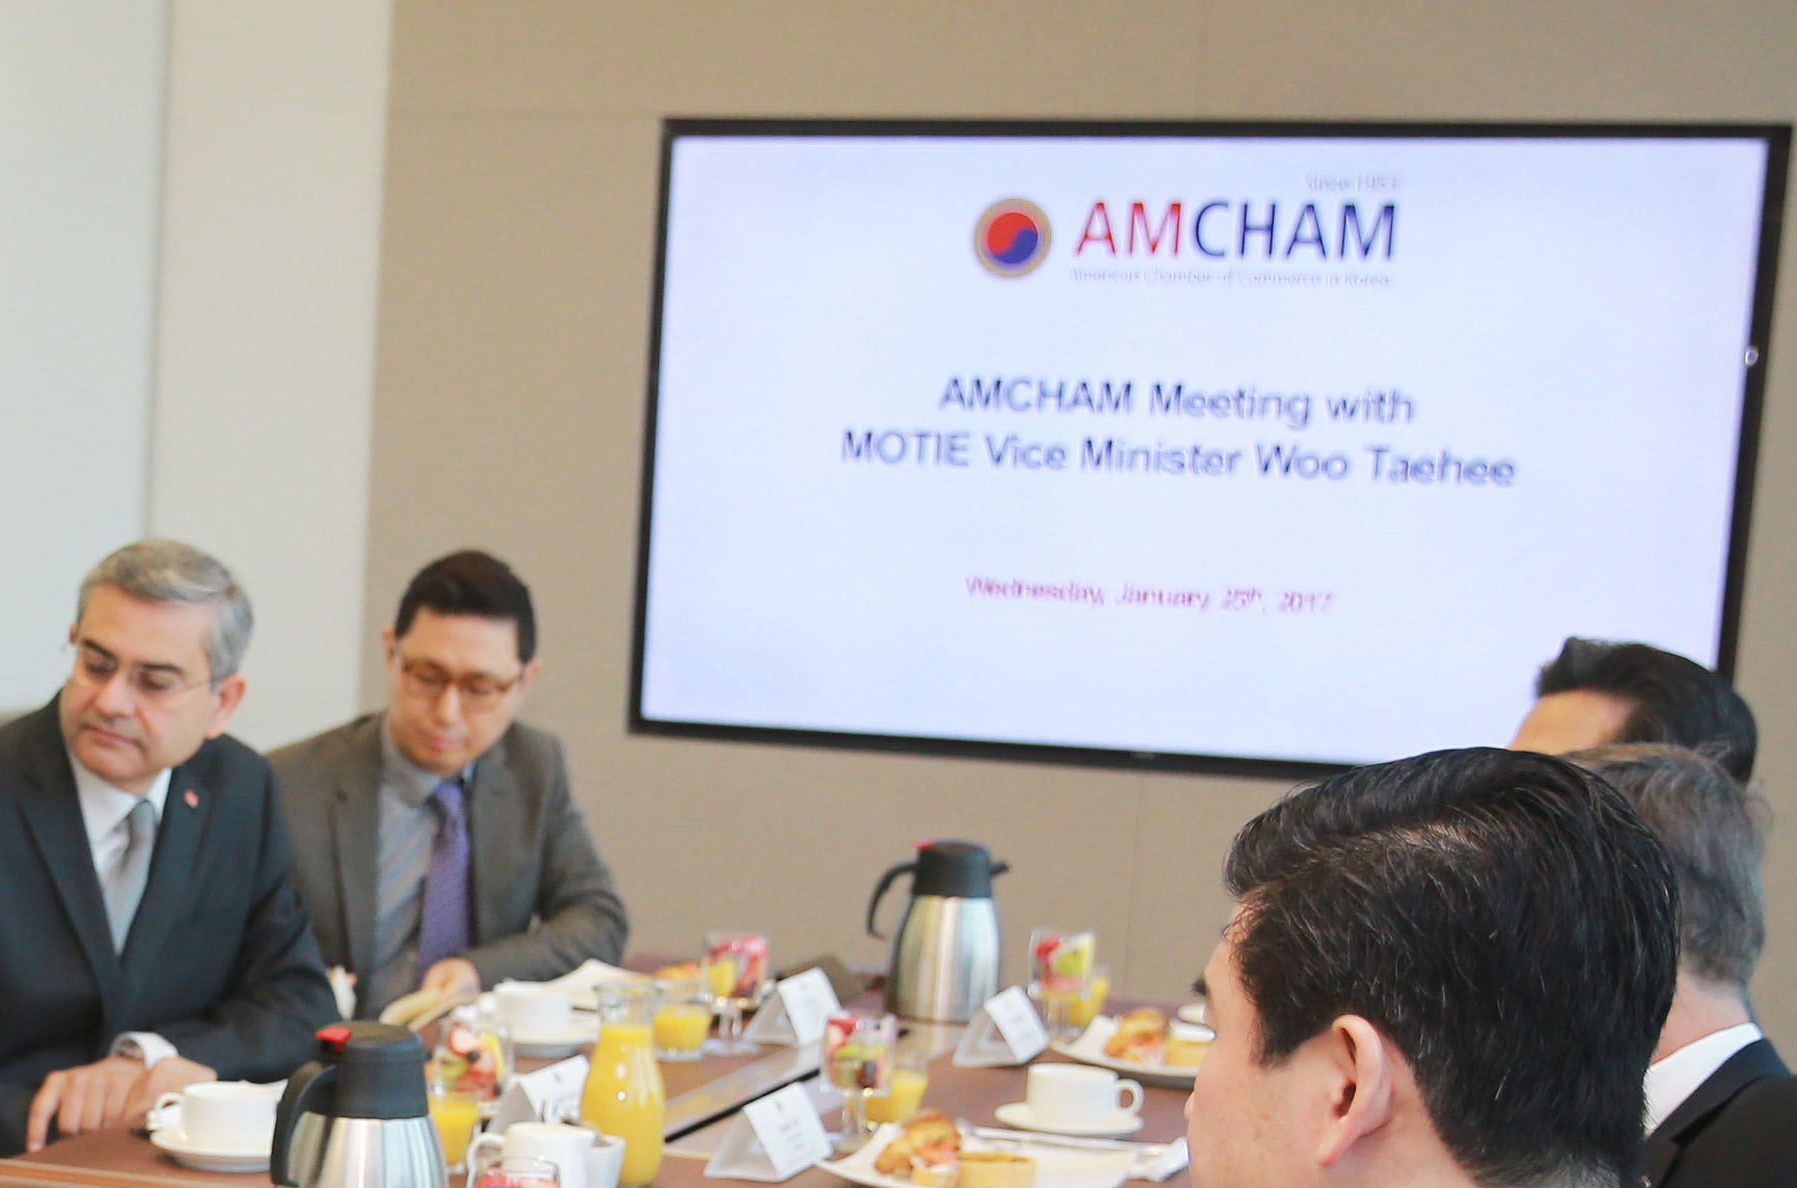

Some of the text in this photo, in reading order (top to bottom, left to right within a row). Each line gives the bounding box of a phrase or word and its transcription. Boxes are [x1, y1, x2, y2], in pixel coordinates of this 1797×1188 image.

[1076, 201, 1396, 259] AMCHAM
[939, 376, 1414, 430] AMCHAM Meeting with
[842, 430, 1516, 486] MOTIE Vice Minister Woo Taehee
[1116, 583, 1210, 612] January
